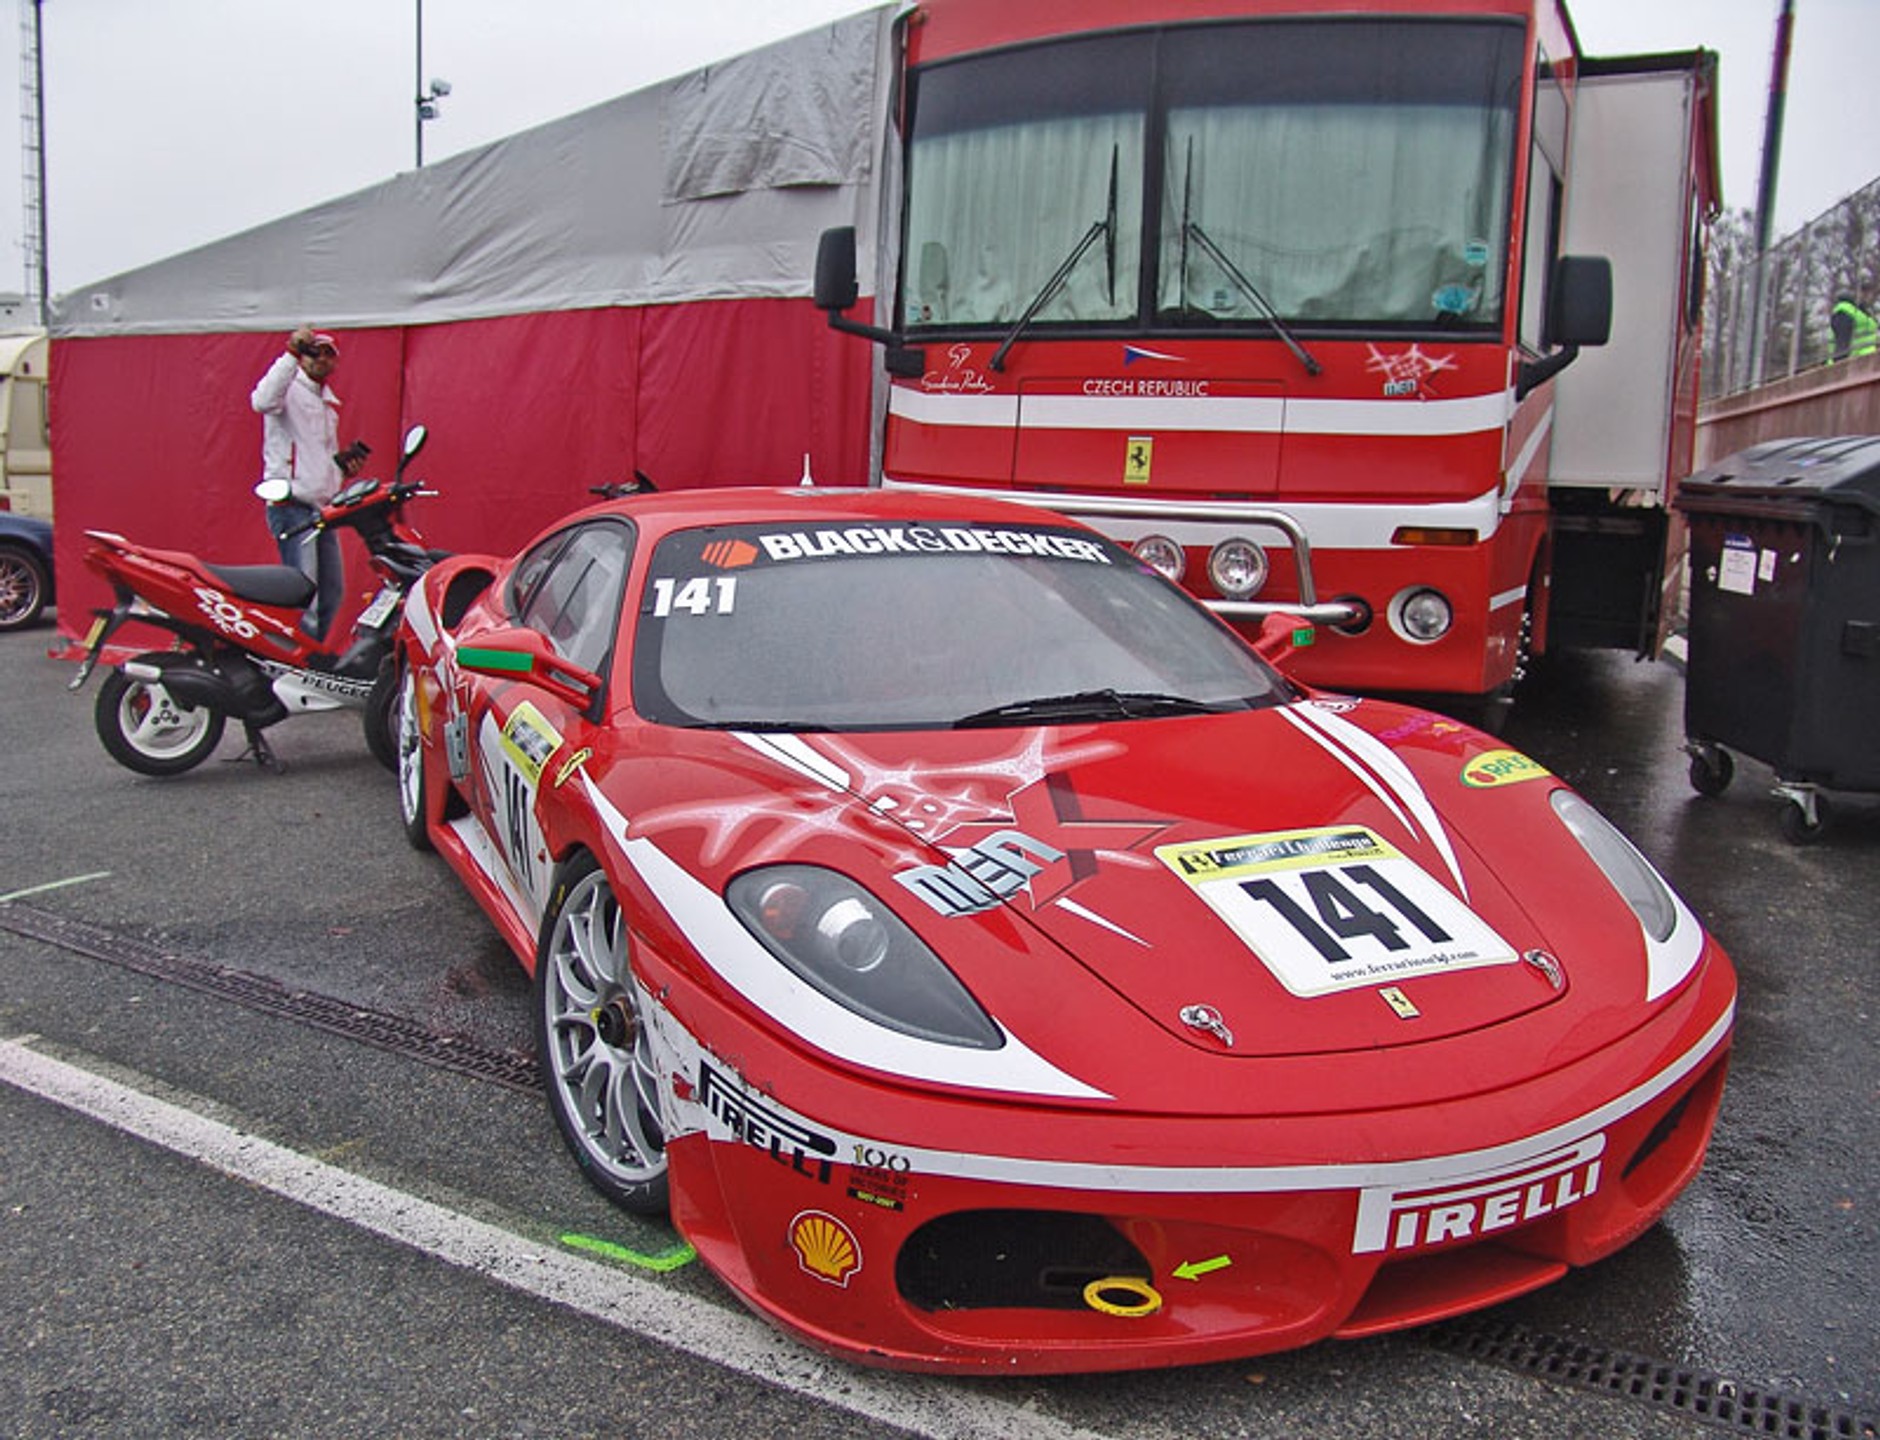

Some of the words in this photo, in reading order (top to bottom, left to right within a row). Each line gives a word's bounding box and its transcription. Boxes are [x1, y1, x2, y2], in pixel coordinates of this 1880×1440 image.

[1083, 380, 1135, 395] CZECH
[1137, 381, 1209, 396] REPUBLIC
[193, 587, 260, 639] 206
[653, 576, 737, 618] 141
[302, 674, 373, 698] PEUGEO
[1209, 845, 1284, 865] Ferrari
[1284, 834, 1374, 856] Challenge
[1238, 863, 1454, 964] 141
[701, 1059, 838, 1185] PIRELLI
[853, 1144, 911, 1173] 100
[1352, 1132, 1607, 1254] PIRELLI
